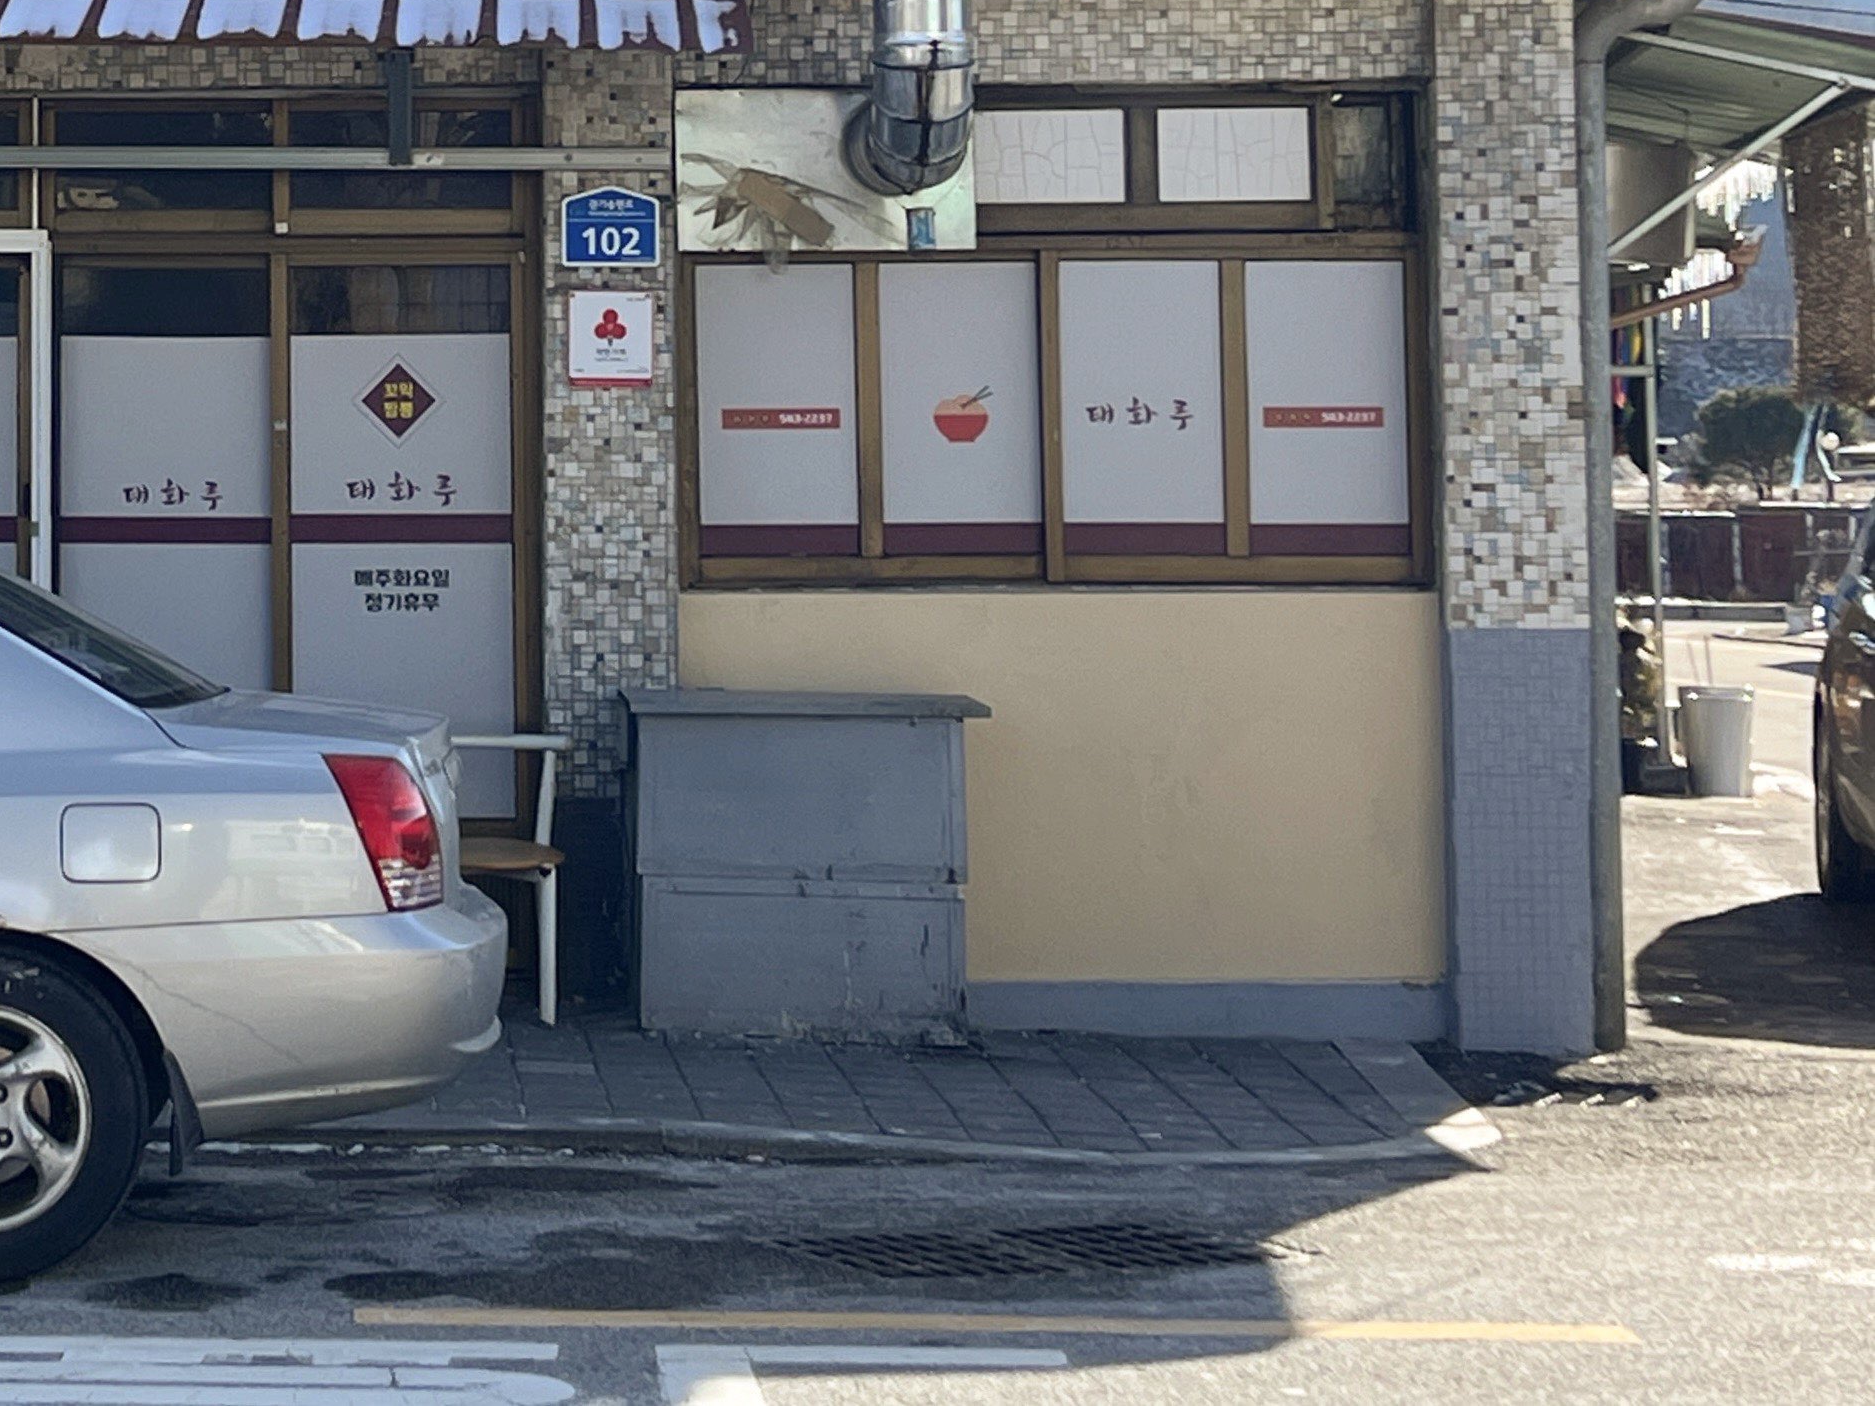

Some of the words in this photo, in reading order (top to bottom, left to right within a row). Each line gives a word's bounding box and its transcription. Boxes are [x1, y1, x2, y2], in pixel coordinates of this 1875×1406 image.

[582, 227, 642, 256] 102
[354, 568, 450, 588] 매주화요일
[365, 592, 440, 612] 정기휴무
